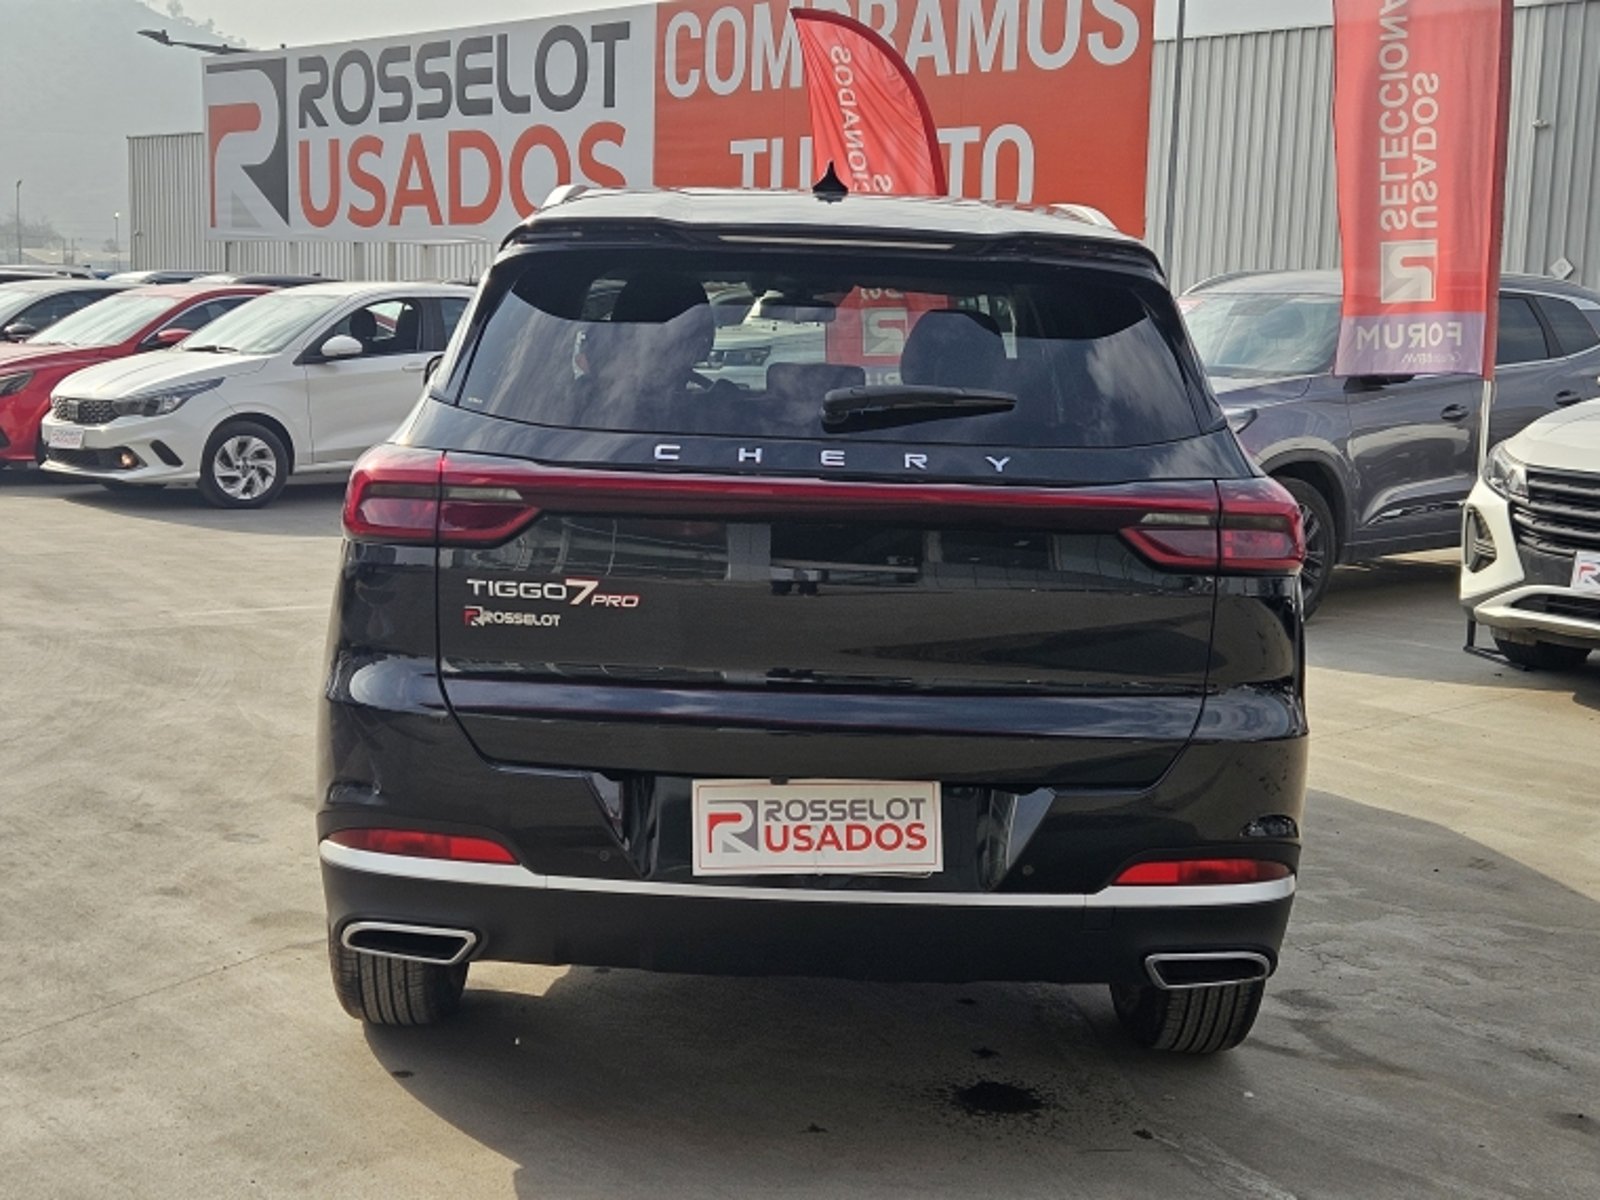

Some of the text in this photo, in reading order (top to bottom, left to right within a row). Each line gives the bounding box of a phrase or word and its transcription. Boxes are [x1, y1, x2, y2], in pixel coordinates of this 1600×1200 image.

[298, 21, 630, 129] ROSSELOT
[664, 0, 1140, 98] COMRAMOS
[299, 121, 627, 227] USADOS
[654, 444, 1010, 472] CHERY
[764, 798, 927, 822] ROSSELOT
[765, 823, 928, 852] USADOS
